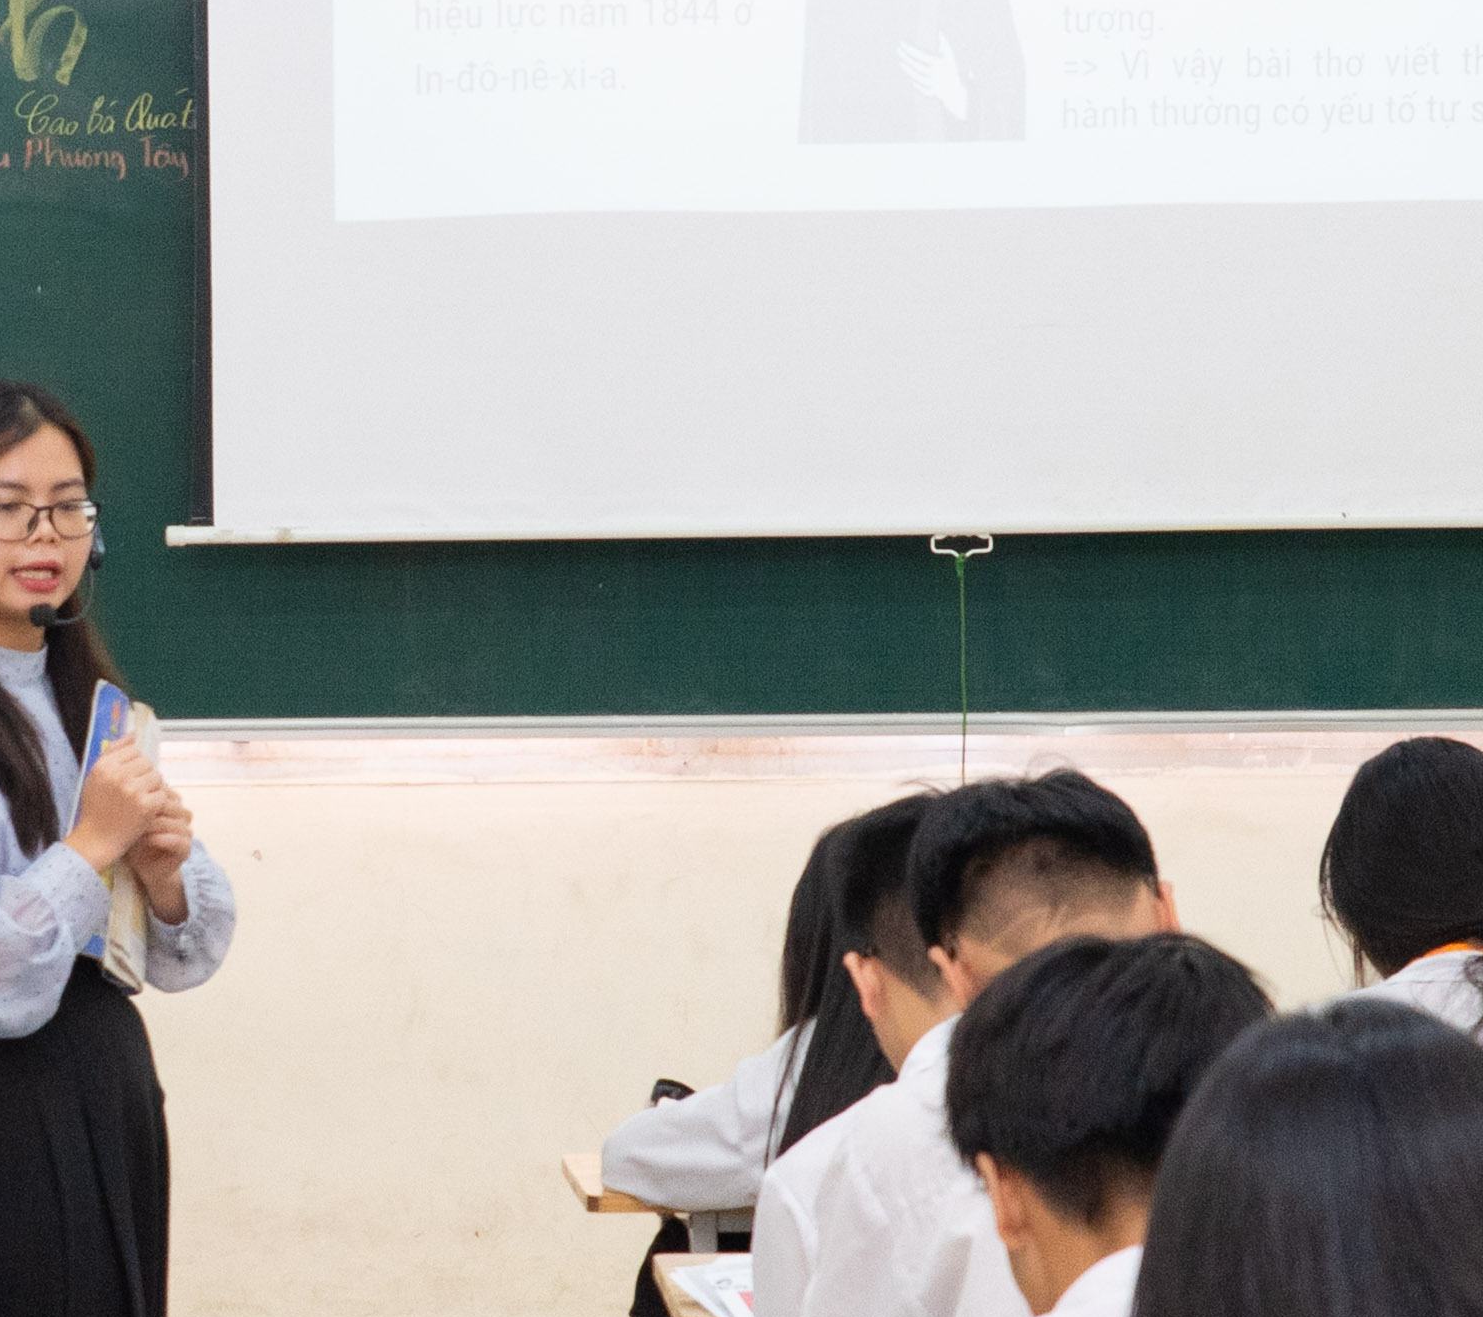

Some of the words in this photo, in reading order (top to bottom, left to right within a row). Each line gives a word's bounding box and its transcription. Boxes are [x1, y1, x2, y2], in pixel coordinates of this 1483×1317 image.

[1062, 6, 1163, 40] tượng.
[416, 59, 625, 95] In-đô-nê-xi-a.
[1121, 49, 1149, 80] Vì
[1173, 48, 1223, 87] vậy
[1246, 47, 1291, 78] bài
[1314, 46, 1364, 78] thơ
[1385, 43, 1439, 76] viết
[15, 89, 79, 135] Cao
[125, 87, 196, 132] Quát
[1062, 97, 1137, 129] hành
[1149, 95, 1260, 134] thường
[1273, 95, 1309, 126] có
[1321, 92, 1373, 134] yếu
[1385, 90, 1417, 123] tố
[1427, 95, 1461, 129] tự
